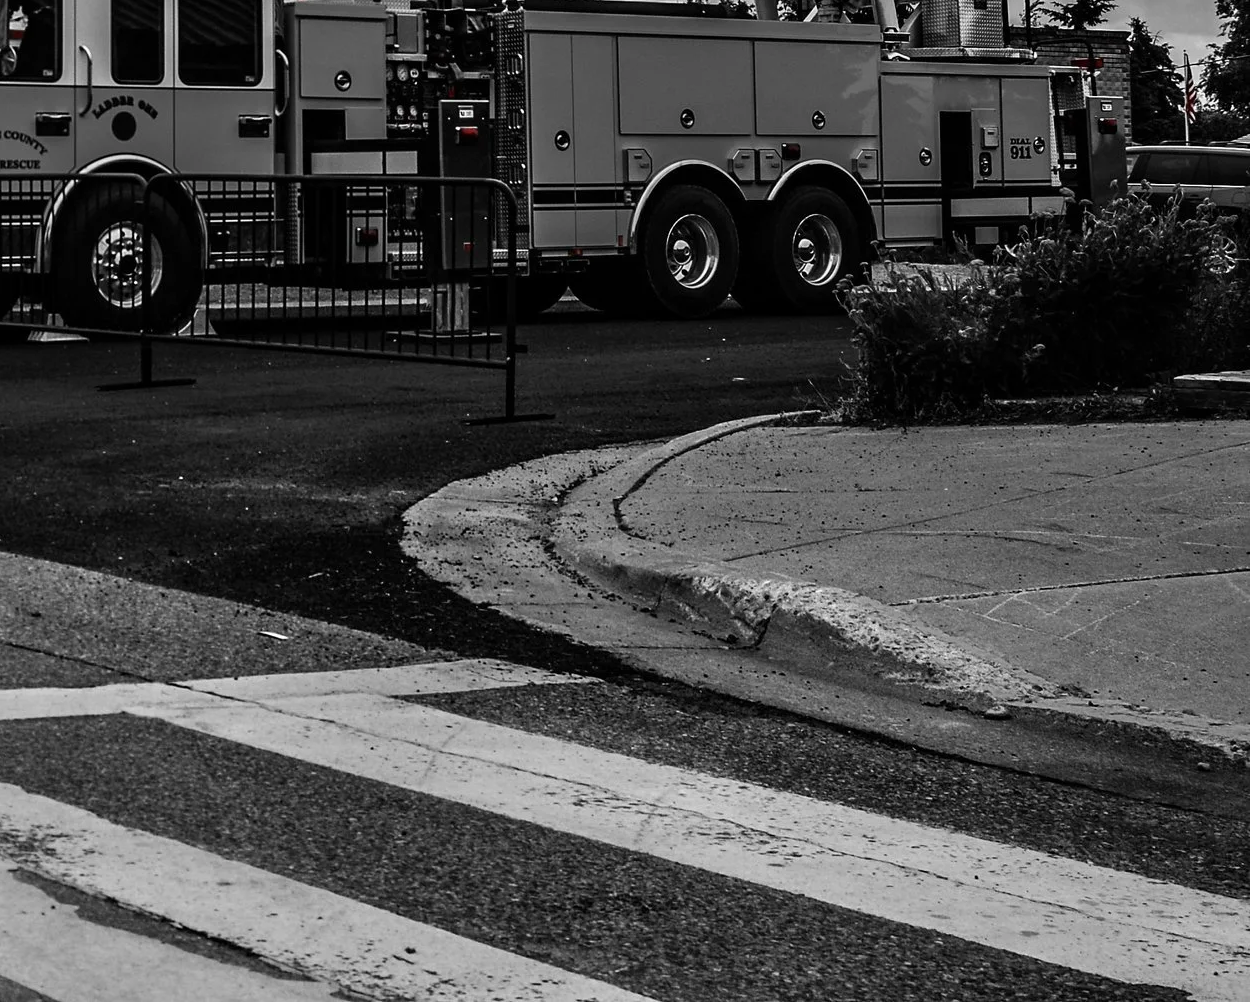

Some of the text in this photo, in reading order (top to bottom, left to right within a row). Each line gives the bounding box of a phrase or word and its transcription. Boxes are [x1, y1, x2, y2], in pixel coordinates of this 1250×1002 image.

[91, 95, 134, 120] LADDER
[3, 129, 49, 156] COUNTY
[1010, 146, 1032, 160] 911
[0, 159, 41, 170] RESCUE
